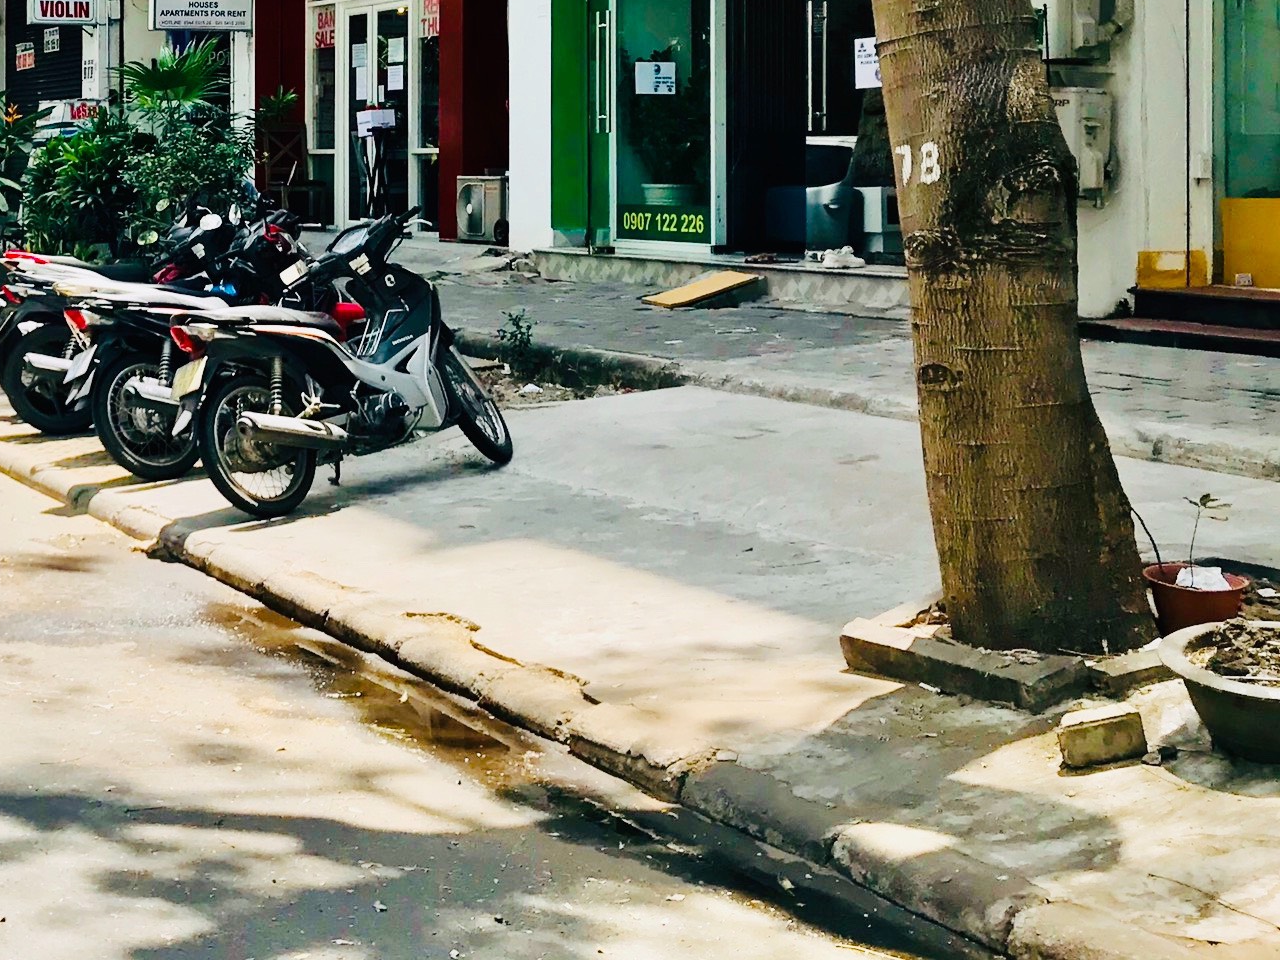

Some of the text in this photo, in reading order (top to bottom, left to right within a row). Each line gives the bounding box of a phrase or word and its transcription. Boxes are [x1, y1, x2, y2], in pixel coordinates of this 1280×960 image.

[40, 0, 90, 18] VIOLIN
[160, 10, 247, 18] APARTMENTS FOR RENT
[188, 1, 219, 9] HOUSES
[315, 30, 335, 49] SALE
[623, 212, 704, 234] 0907 122 226
